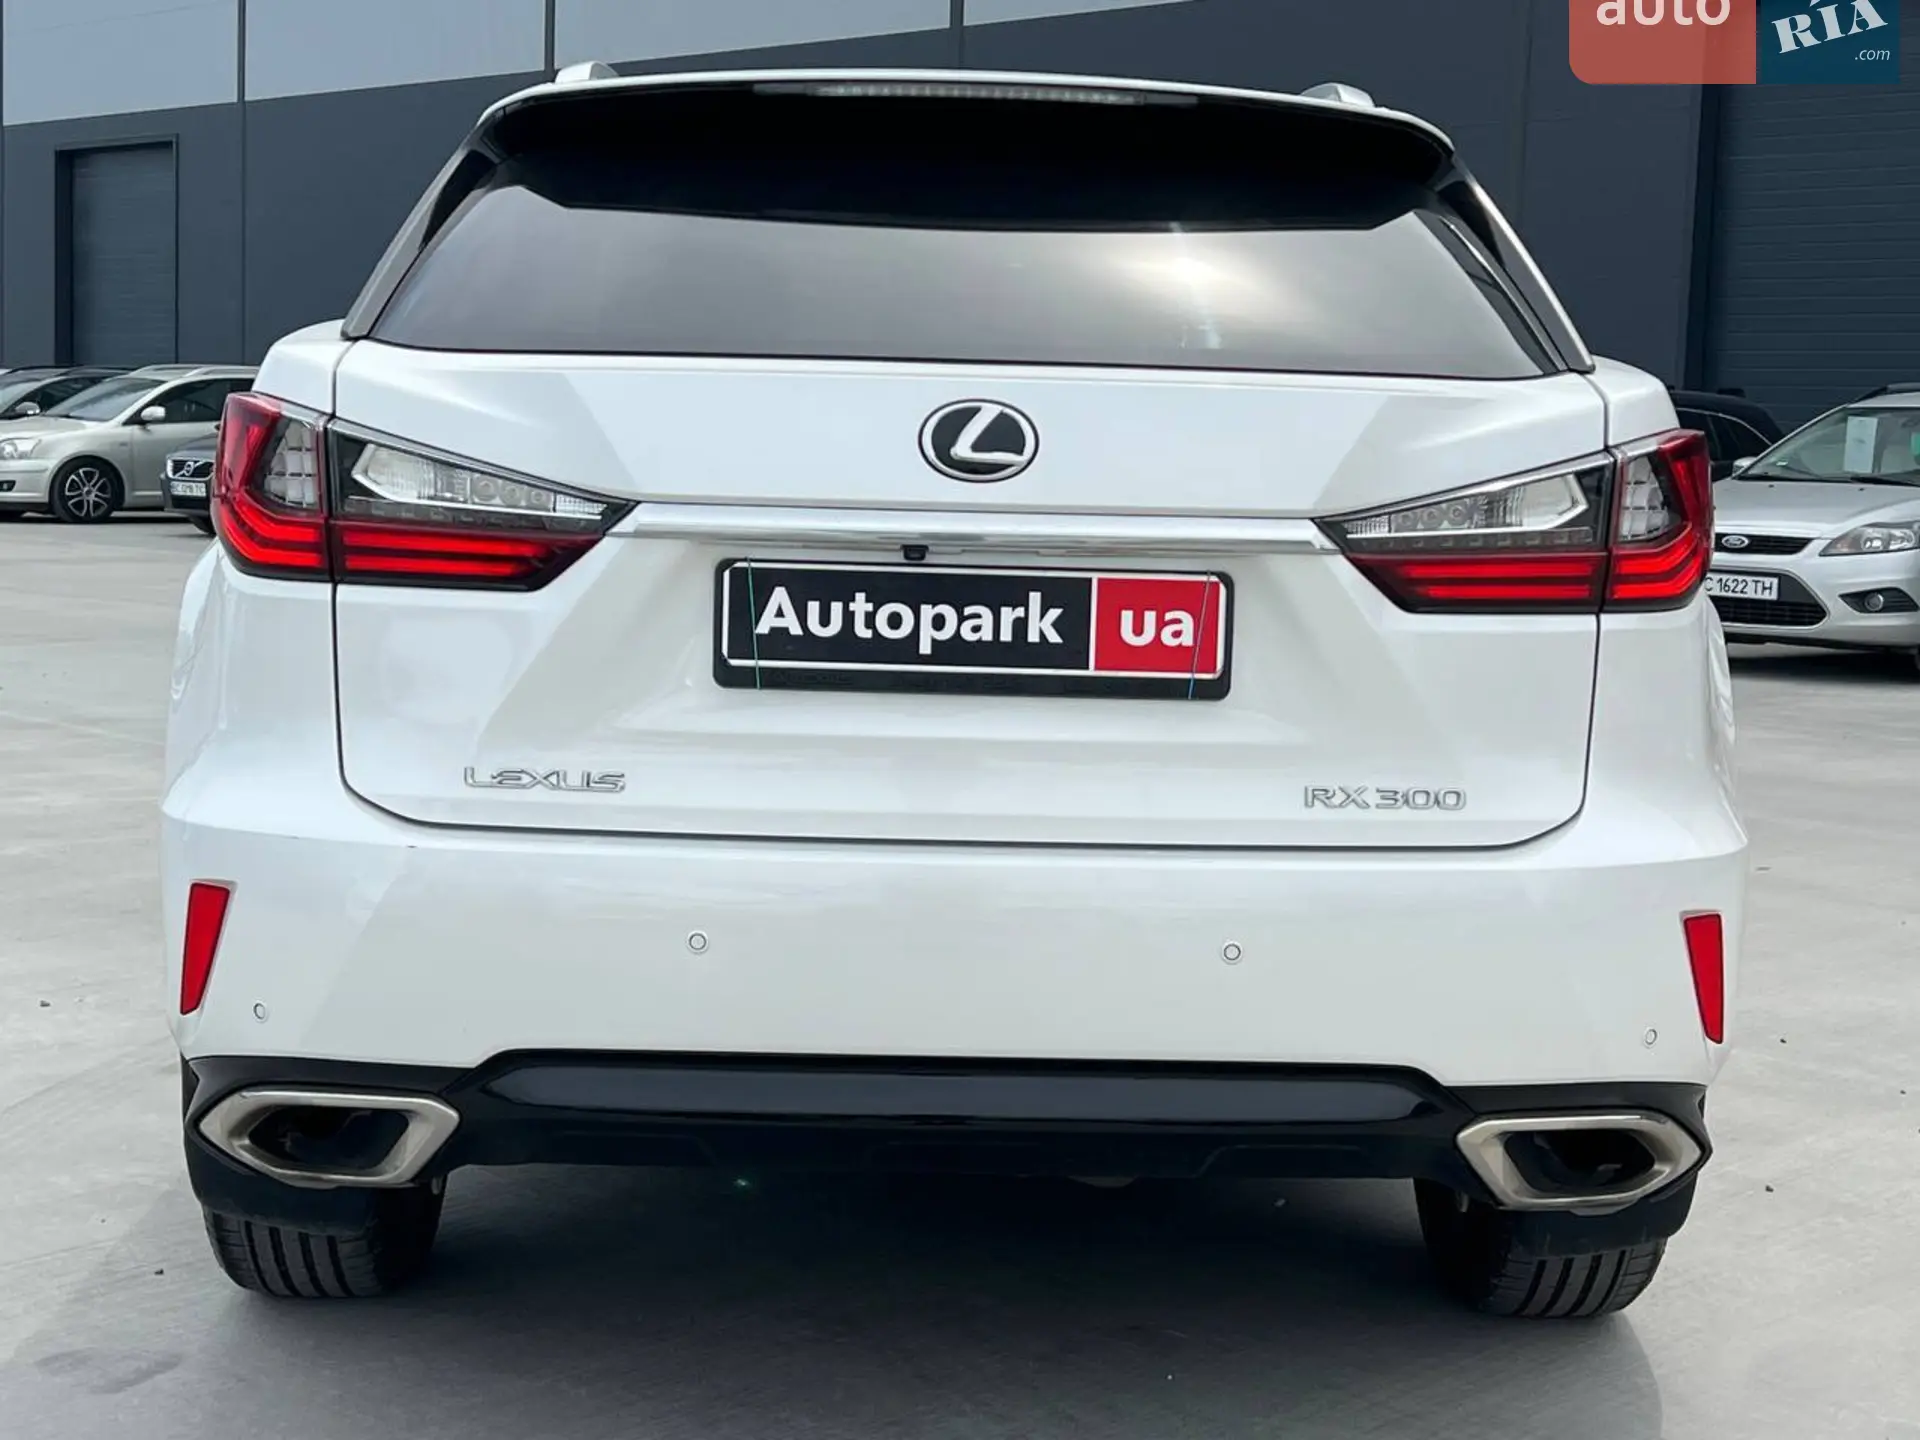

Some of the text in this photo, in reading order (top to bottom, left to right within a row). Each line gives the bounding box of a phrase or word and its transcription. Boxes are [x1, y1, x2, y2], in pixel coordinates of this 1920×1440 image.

[1717, 577, 1748, 595] 1622
[1752, 579, 1773, 596] TH
[754, 585, 1195, 655] Autopark ua
[464, 766, 626, 793] LEXUS
[1304, 785, 1467, 811] RX 300
